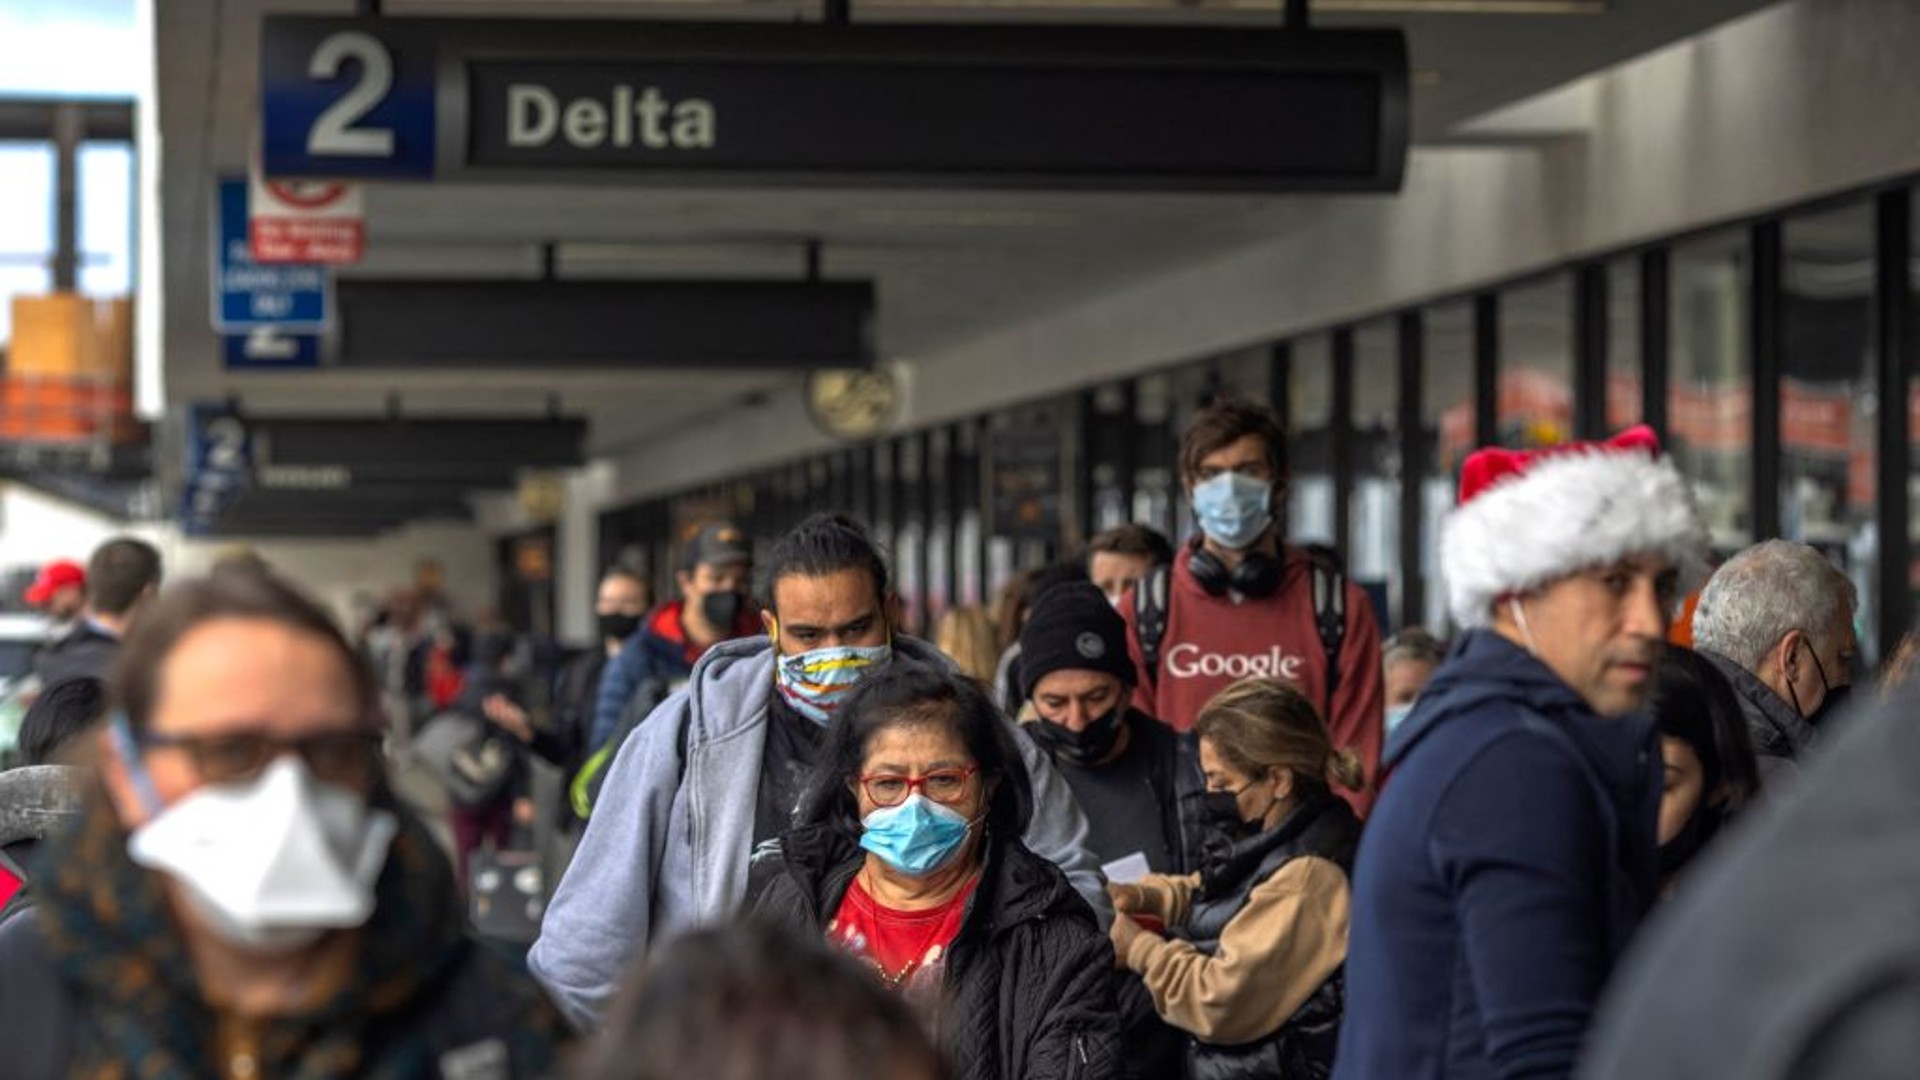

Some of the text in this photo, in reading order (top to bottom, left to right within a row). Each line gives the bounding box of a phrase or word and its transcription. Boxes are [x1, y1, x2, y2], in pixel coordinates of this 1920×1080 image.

[306, 31, 395, 156] 2
[506, 84, 716, 147] Delta
[1166, 643, 1302, 678] Google
